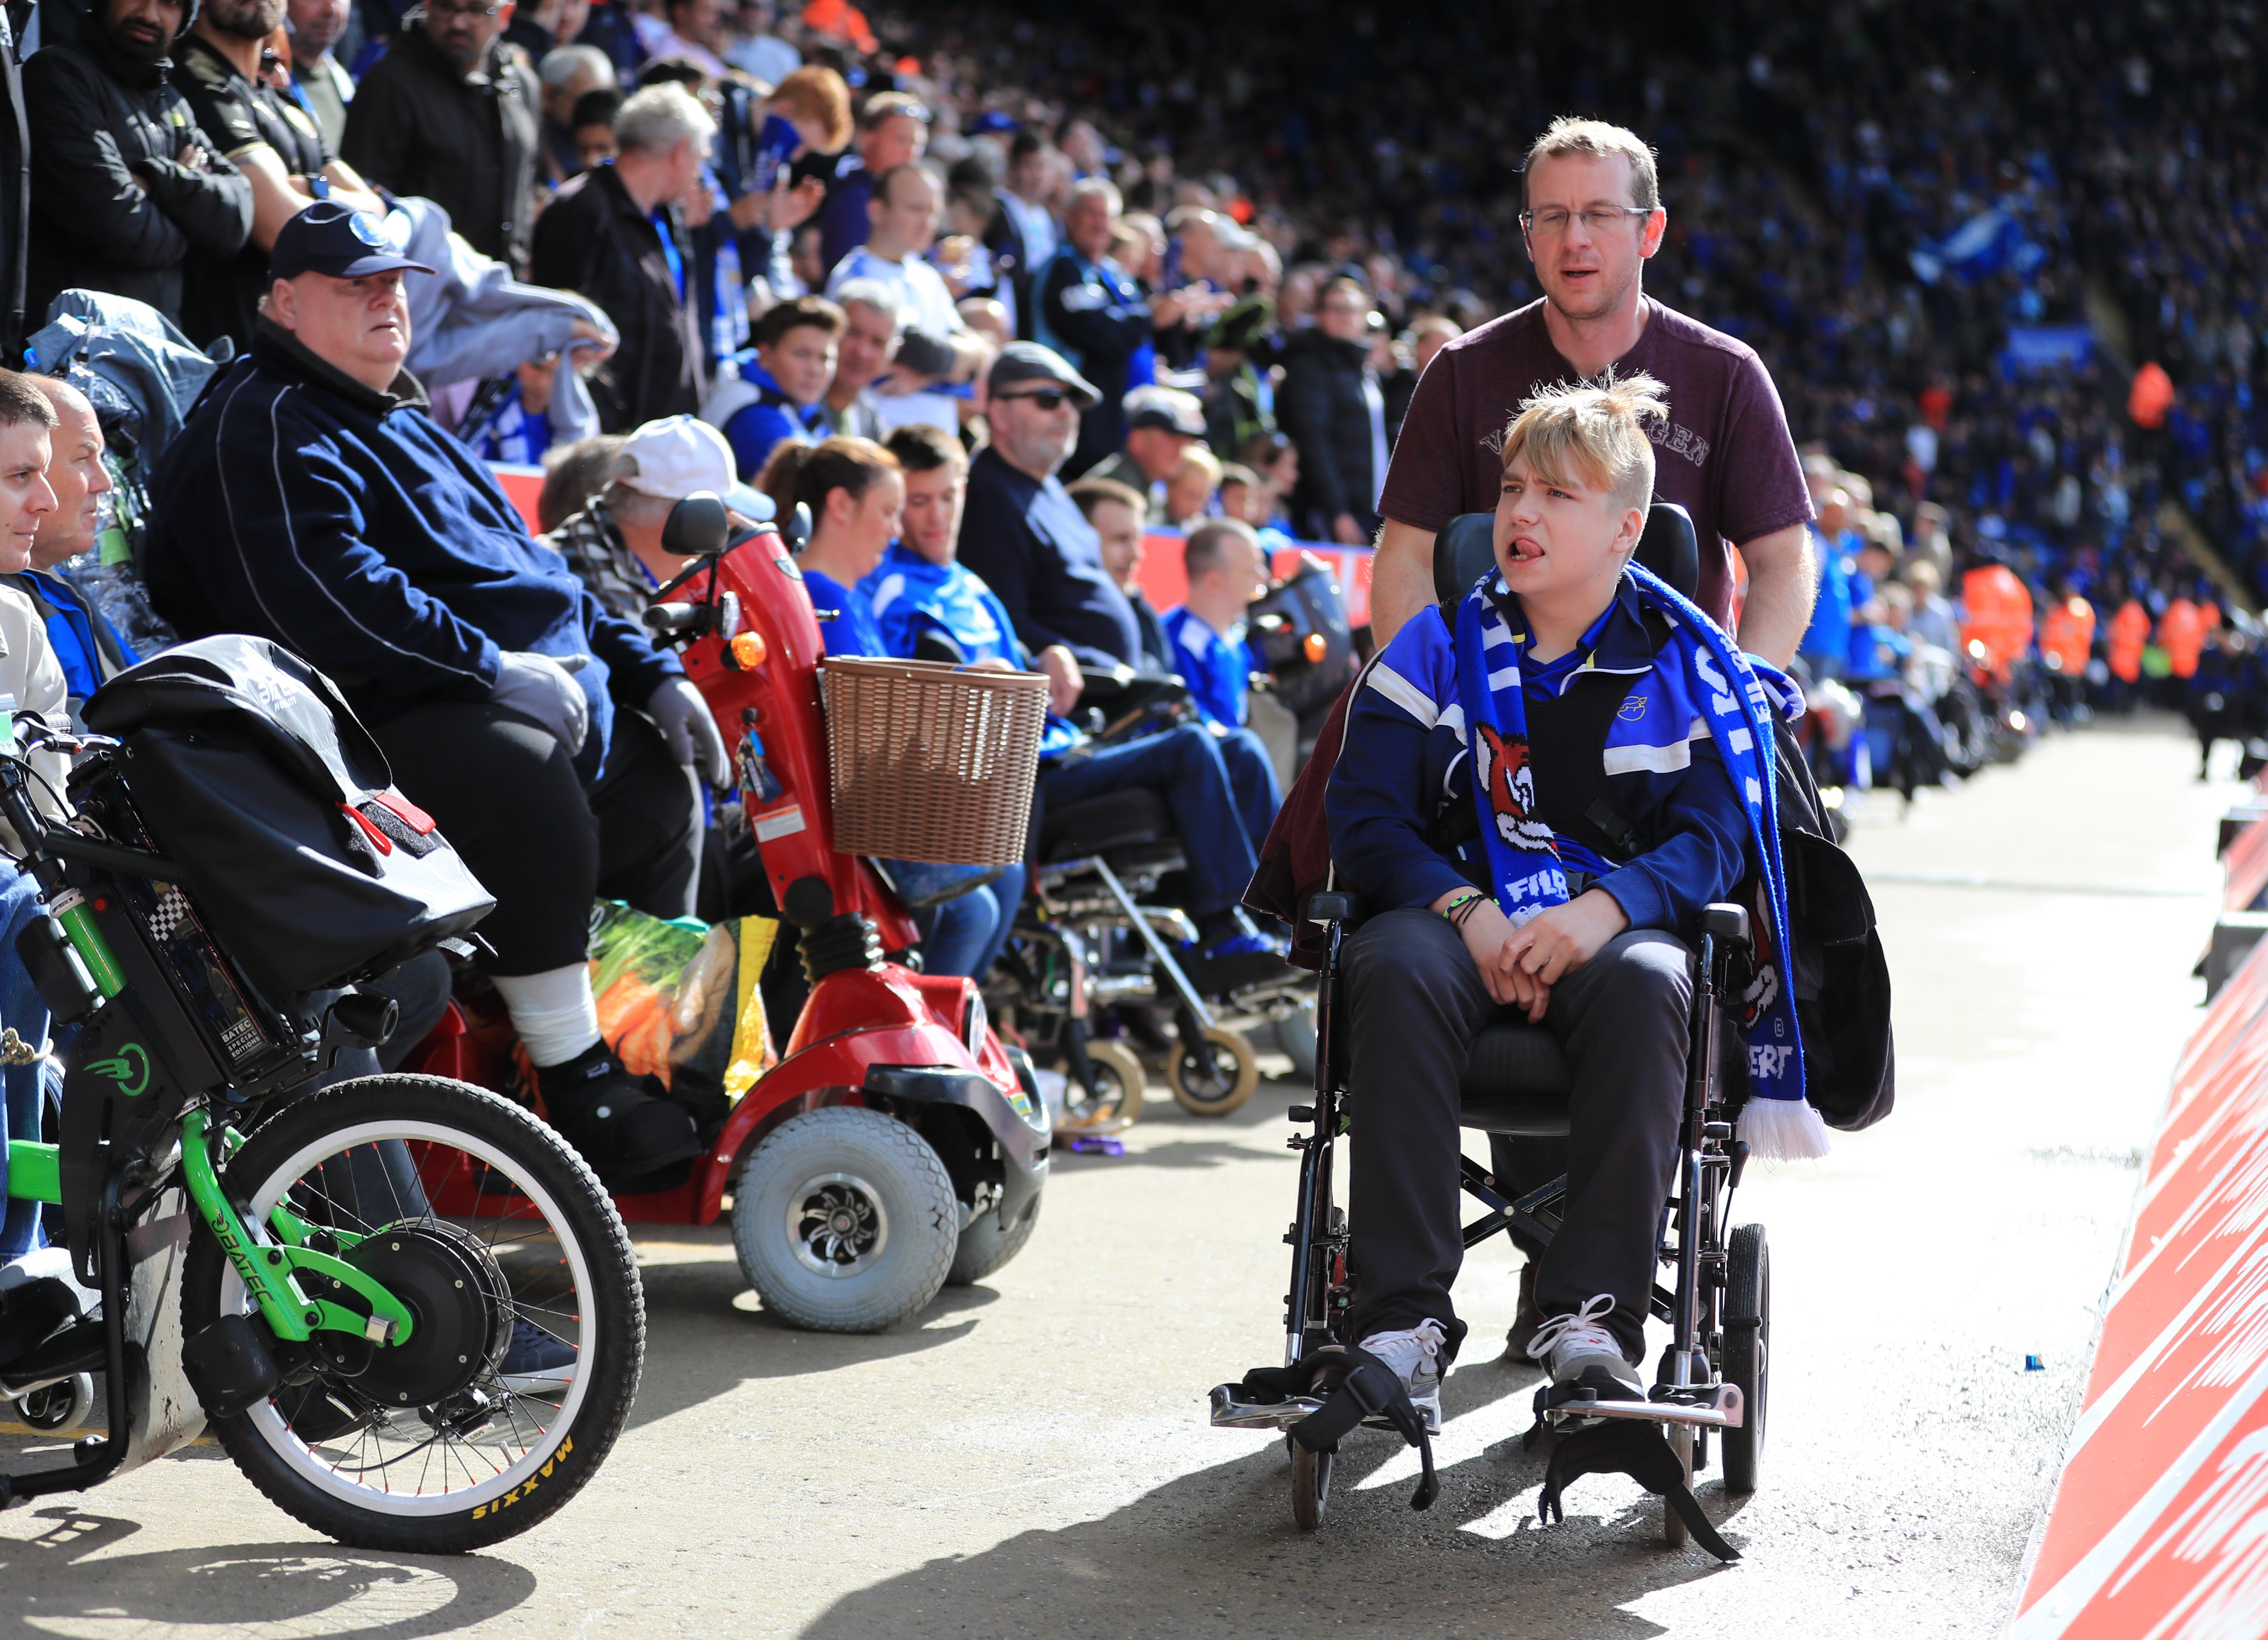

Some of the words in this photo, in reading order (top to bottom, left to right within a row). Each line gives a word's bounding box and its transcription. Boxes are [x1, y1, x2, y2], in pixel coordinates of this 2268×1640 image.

[1505, 868, 1569, 903] FILB
[221, 1019, 252, 1043] BATEC
[228, 1031, 257, 1052] SPECIAL
[231, 1036, 260, 1058] EDITIONS
[220, 1234, 275, 1305] BATEC
[472, 1435, 574, 1520] MAXXIS
